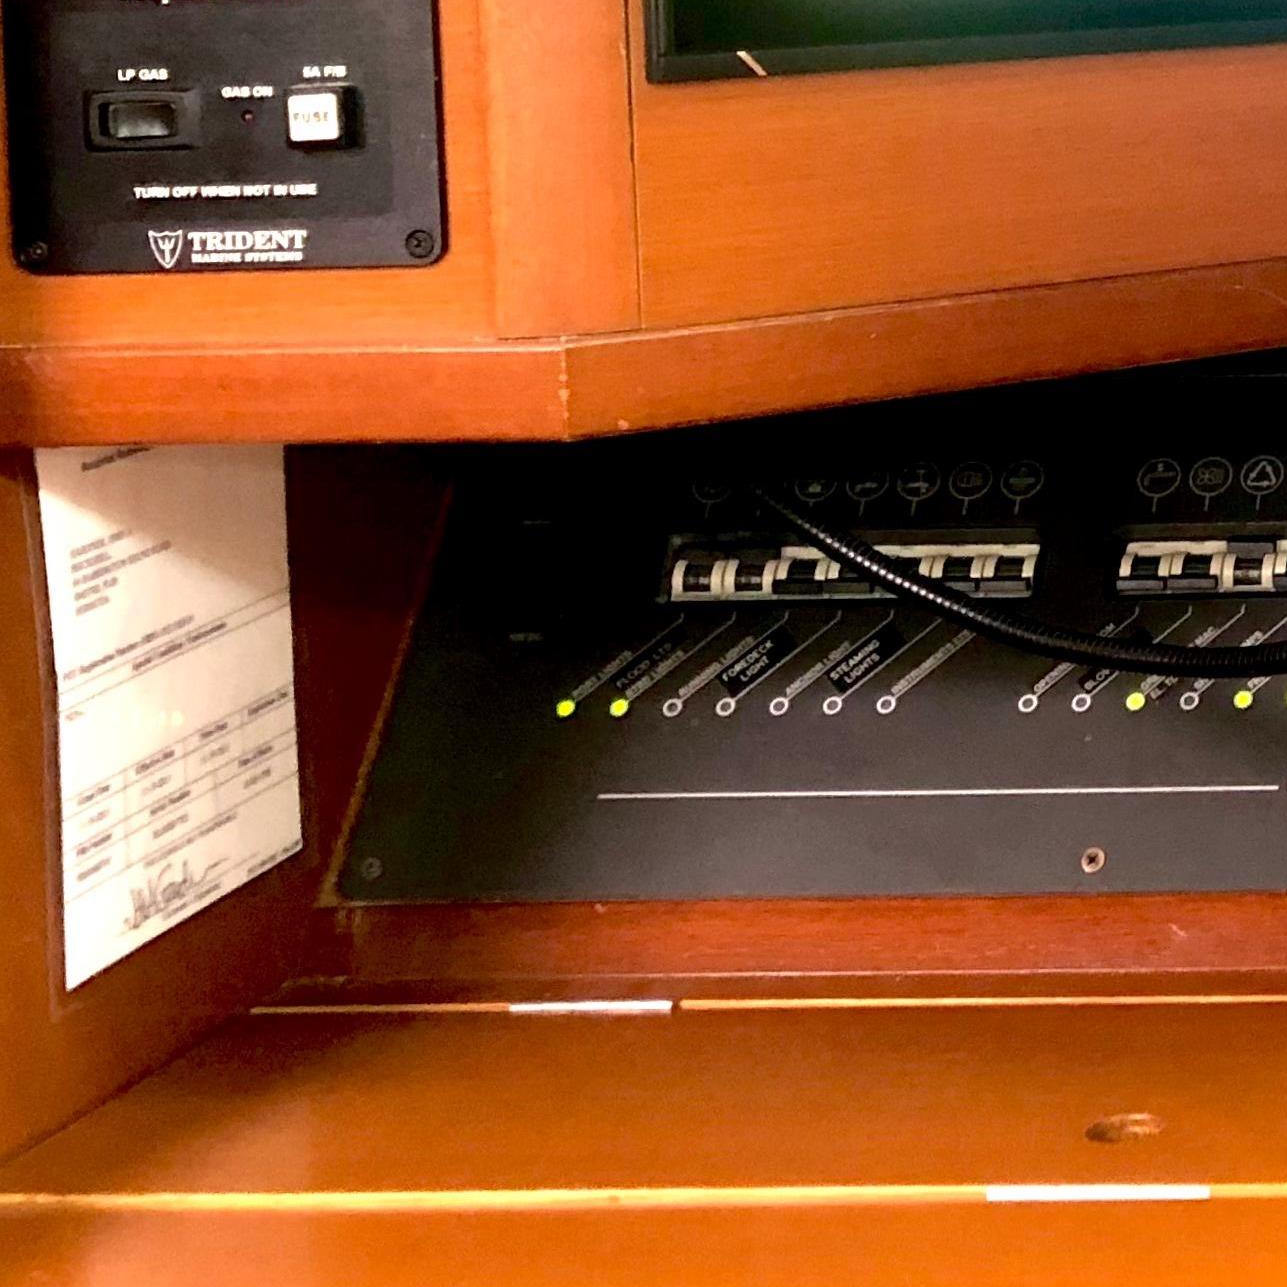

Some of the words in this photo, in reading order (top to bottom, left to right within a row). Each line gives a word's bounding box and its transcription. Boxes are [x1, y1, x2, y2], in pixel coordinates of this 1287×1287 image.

[117, 68, 136, 82] LP
[138, 68, 169, 81] GAS
[220, 85, 250, 98] GAS
[252, 85, 274, 97] ON
[293, 111, 329, 123] FUSE
[133, 186, 170, 199] TURN
[172, 185, 200, 198] OFF
[243, 184, 271, 196] NOT
[273, 184, 288, 196] IN
[289, 183, 317, 196] USE
[187, 229, 308, 251] TRIDENT
[721, 638, 775, 683] FOREDECK
[739, 655, 770, 683] LIGHT
[829, 638, 881, 681] STEAMING
[843, 652, 881, 684] LIGHTS
